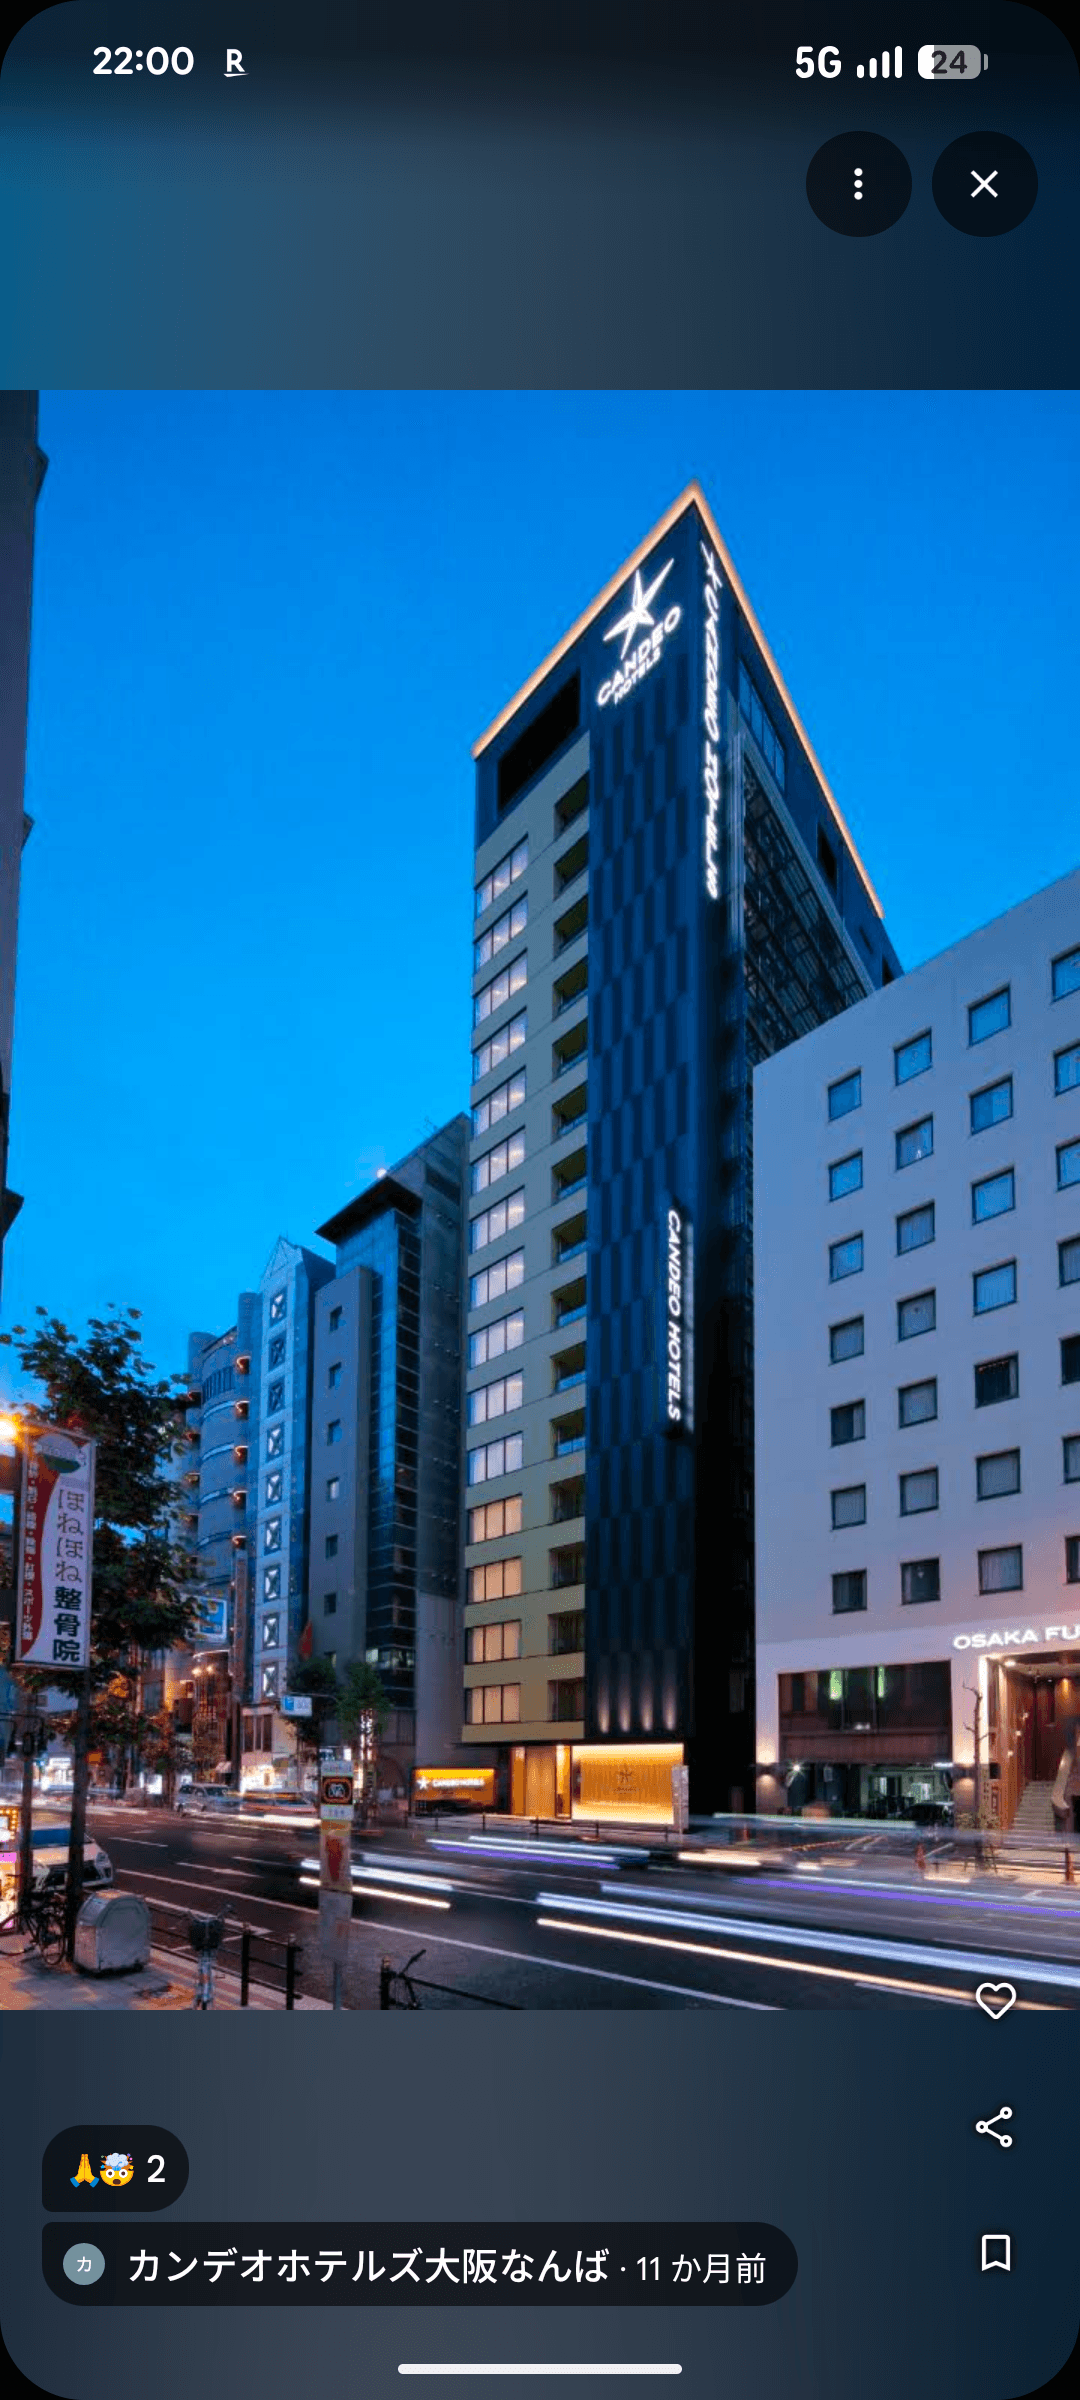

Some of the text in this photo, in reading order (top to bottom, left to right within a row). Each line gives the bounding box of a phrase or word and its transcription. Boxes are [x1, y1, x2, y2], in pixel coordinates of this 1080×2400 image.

[597, 606, 681, 706] CANDEO
[614, 647, 660, 705] HOTELS
[667, 1209, 682, 1422] CANDEO HOTELS
[52, 1488, 85, 1663] ほねほね整骨院
[953, 1628, 1039, 1650] OSAKA
